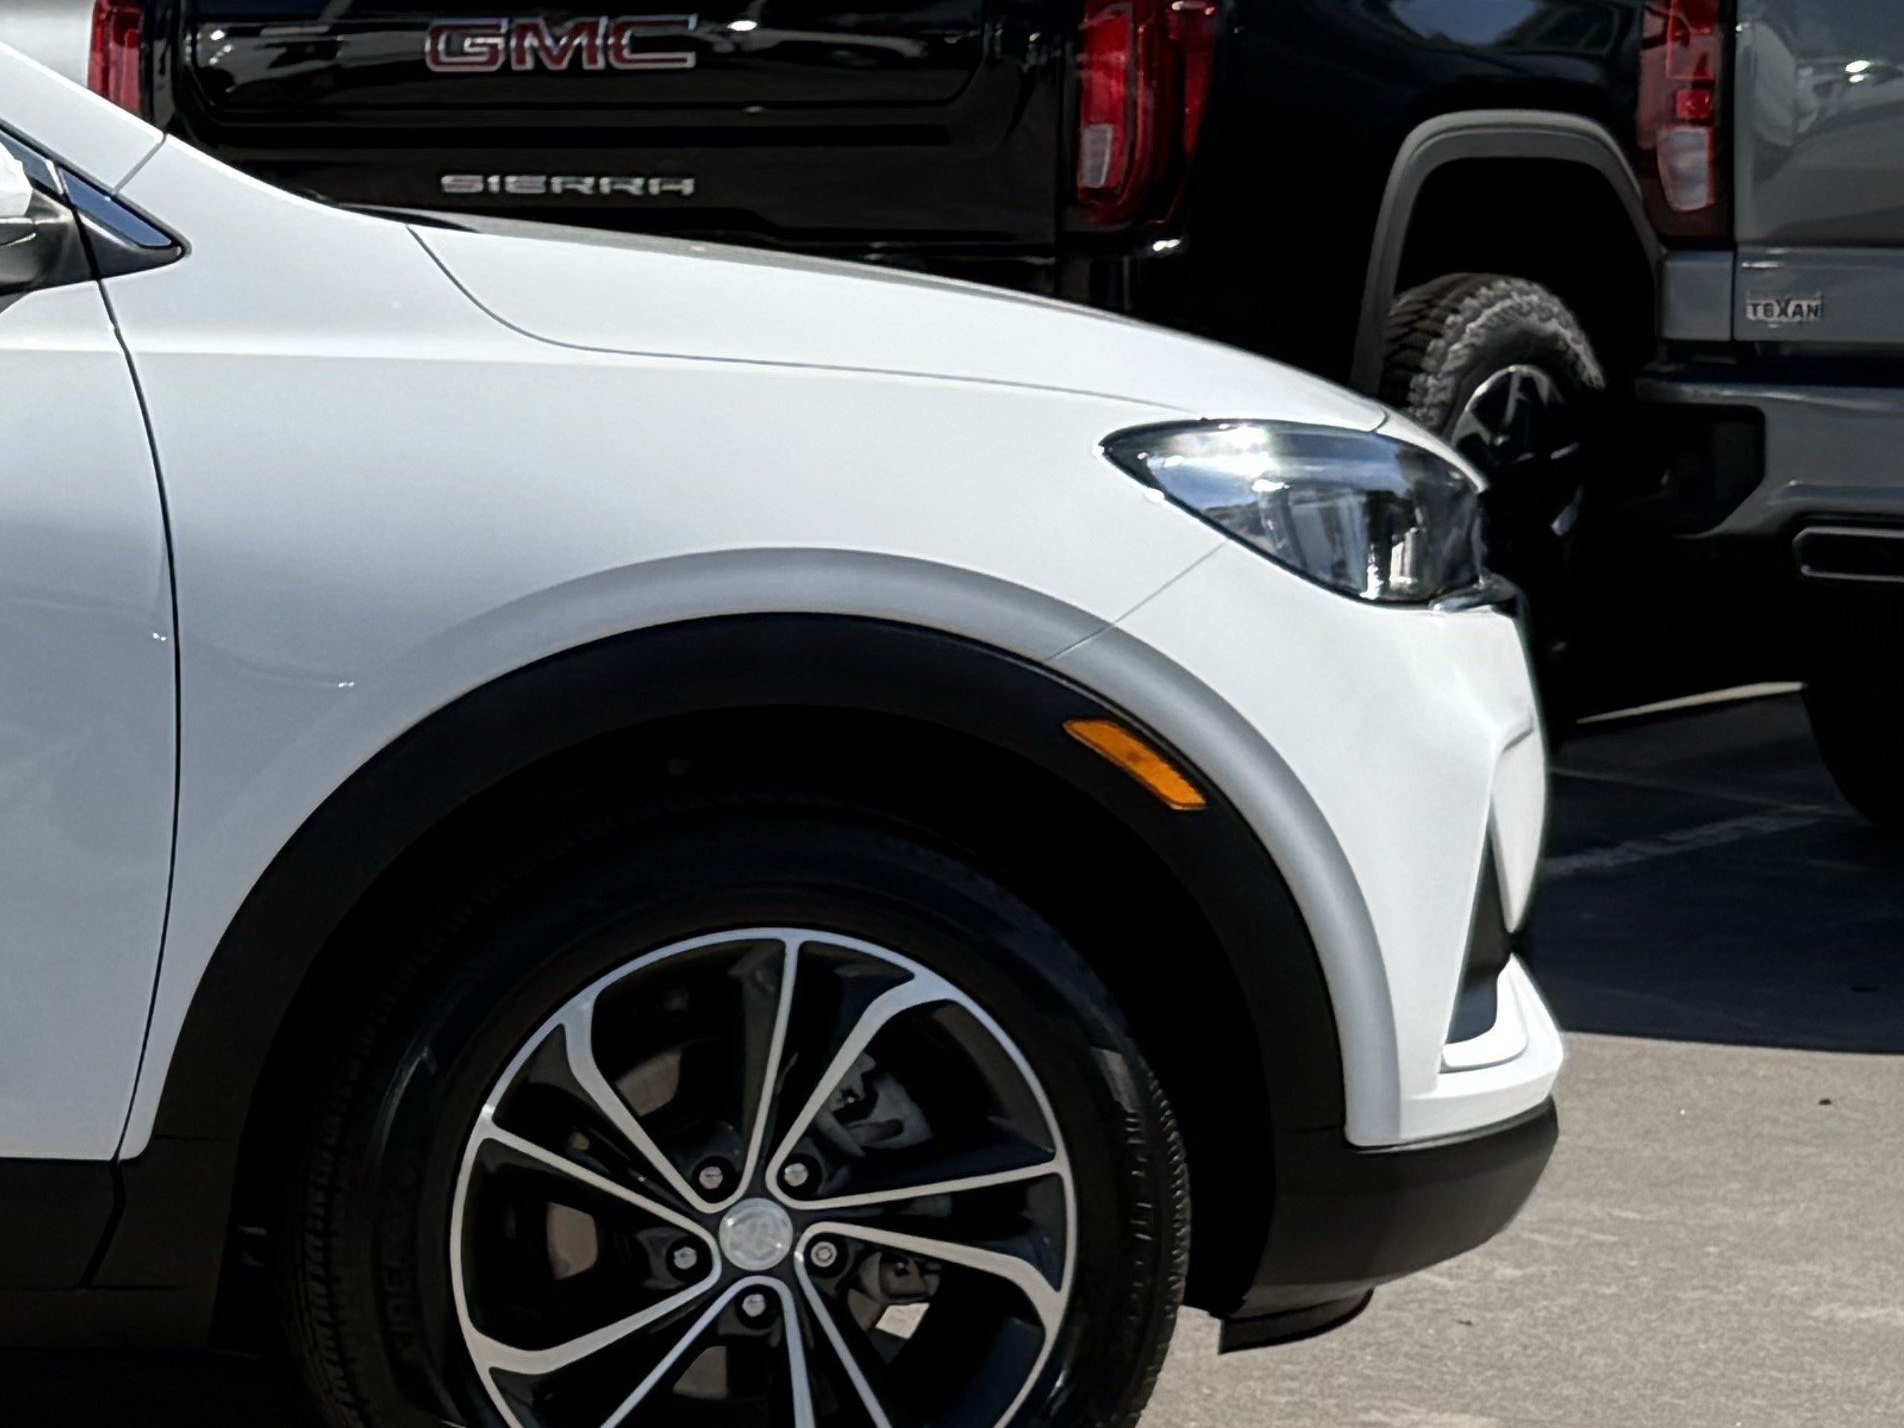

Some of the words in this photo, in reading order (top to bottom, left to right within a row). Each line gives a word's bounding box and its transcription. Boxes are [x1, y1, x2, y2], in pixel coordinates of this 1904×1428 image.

[424, 13, 698, 73] GMC
[440, 174, 696, 197] SIERRA
[1750, 299, 1820, 319] TEXAN
